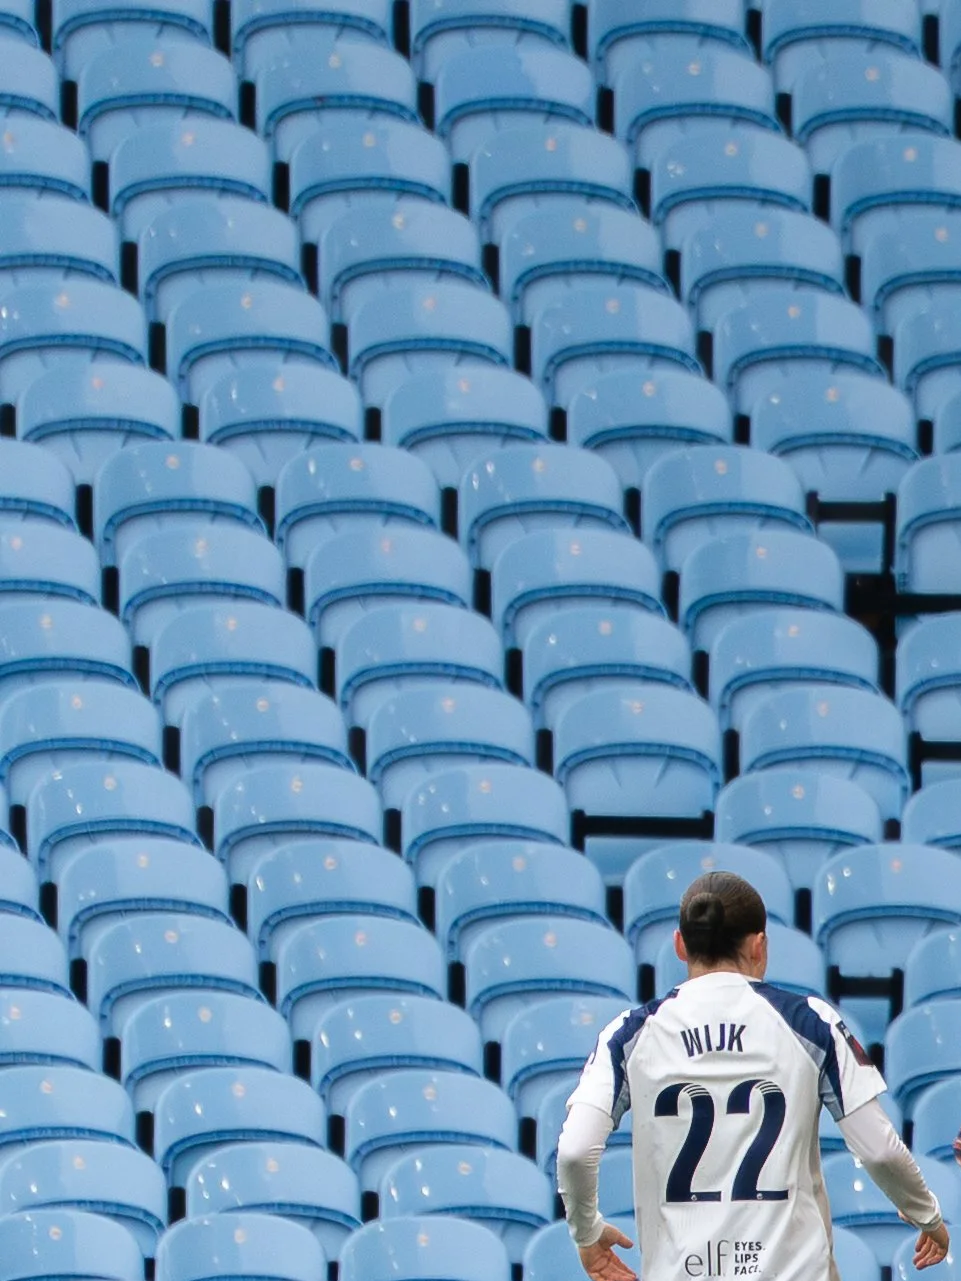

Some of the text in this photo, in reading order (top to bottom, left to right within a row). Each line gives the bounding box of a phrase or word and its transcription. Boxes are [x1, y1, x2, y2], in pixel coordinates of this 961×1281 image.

[680, 1023, 747, 1058] WIJK
[654, 1079, 789, 1203] 22
[734, 1253, 759, 1264] LIPS
